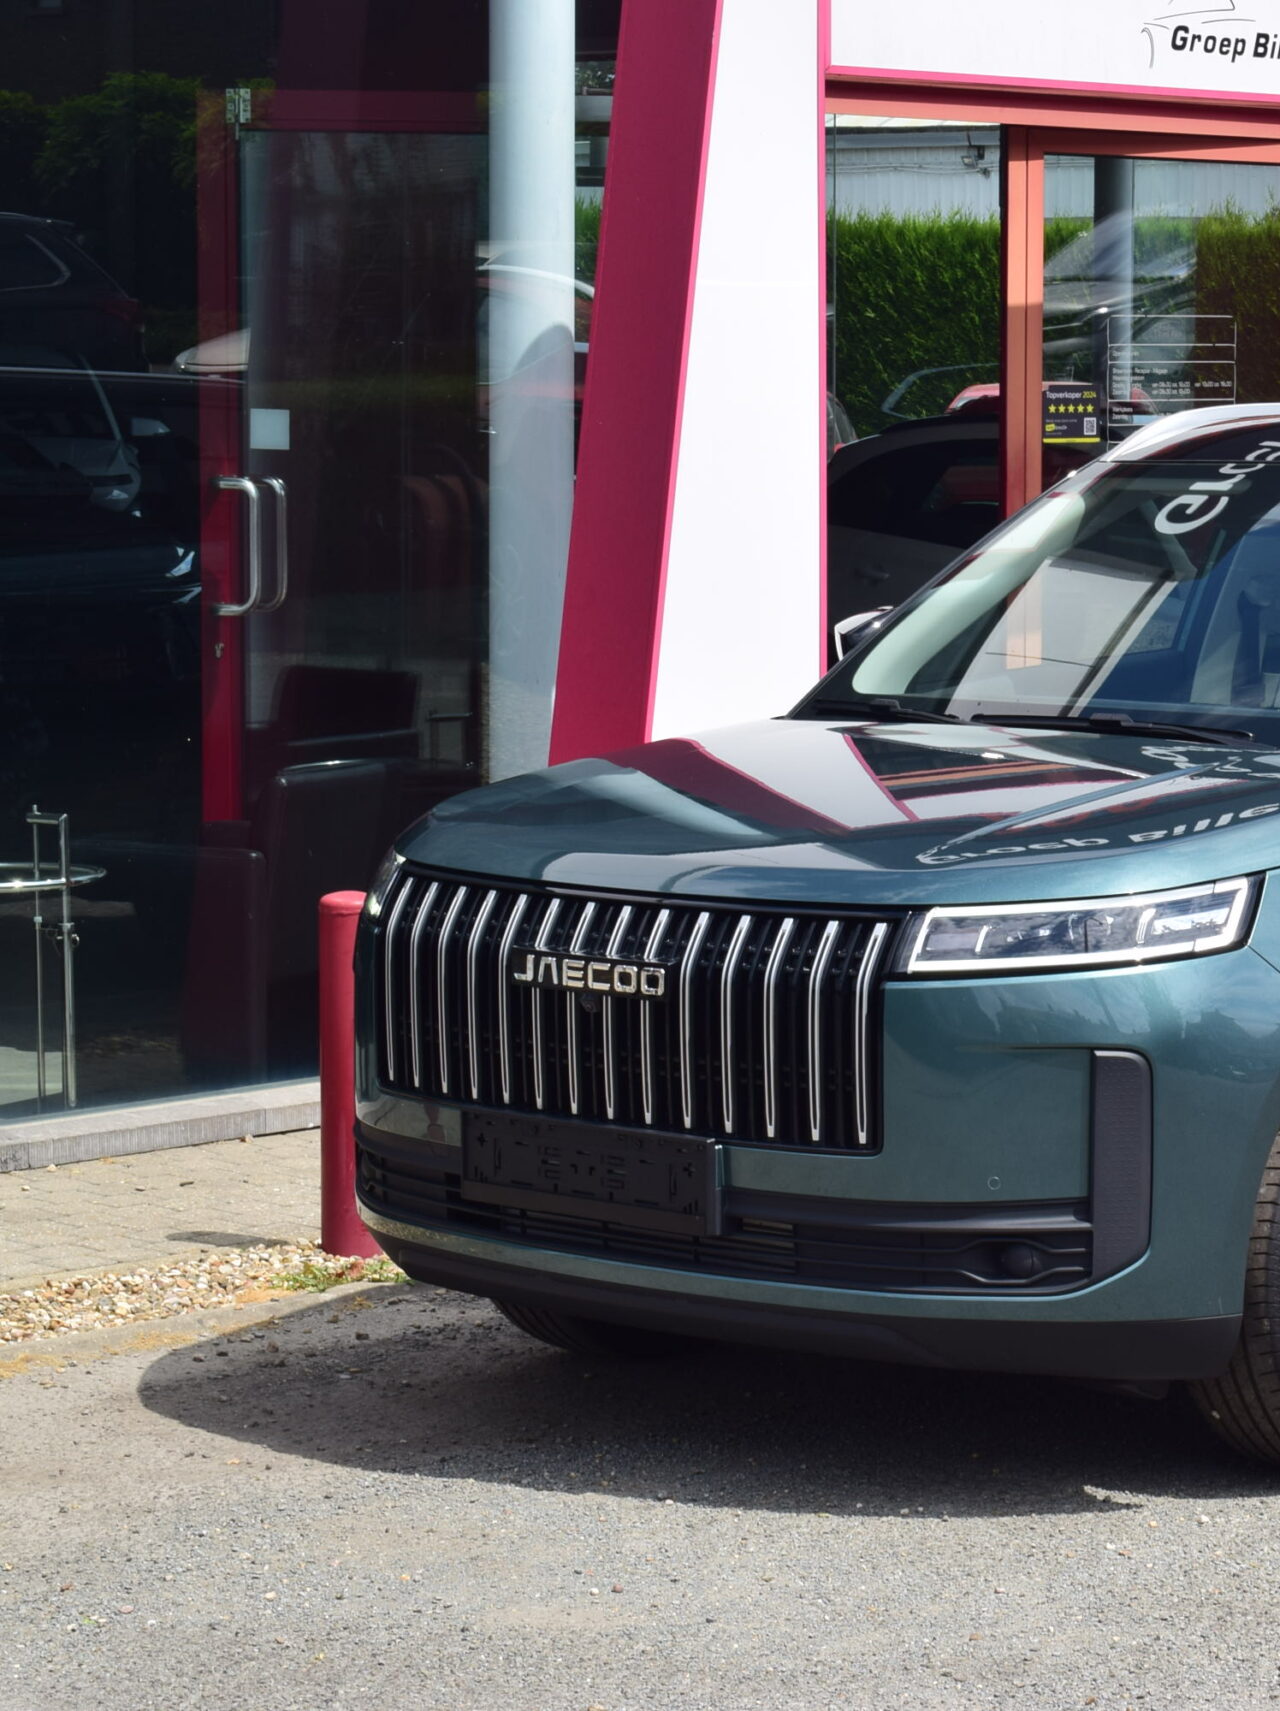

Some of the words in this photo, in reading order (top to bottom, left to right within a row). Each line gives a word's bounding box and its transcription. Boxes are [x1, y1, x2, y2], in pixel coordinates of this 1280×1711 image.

[1170, 25, 1247, 63] Groep
[1046, 391, 1082, 400] Topverkoper
[513, 953, 666, 997] JAECOO
